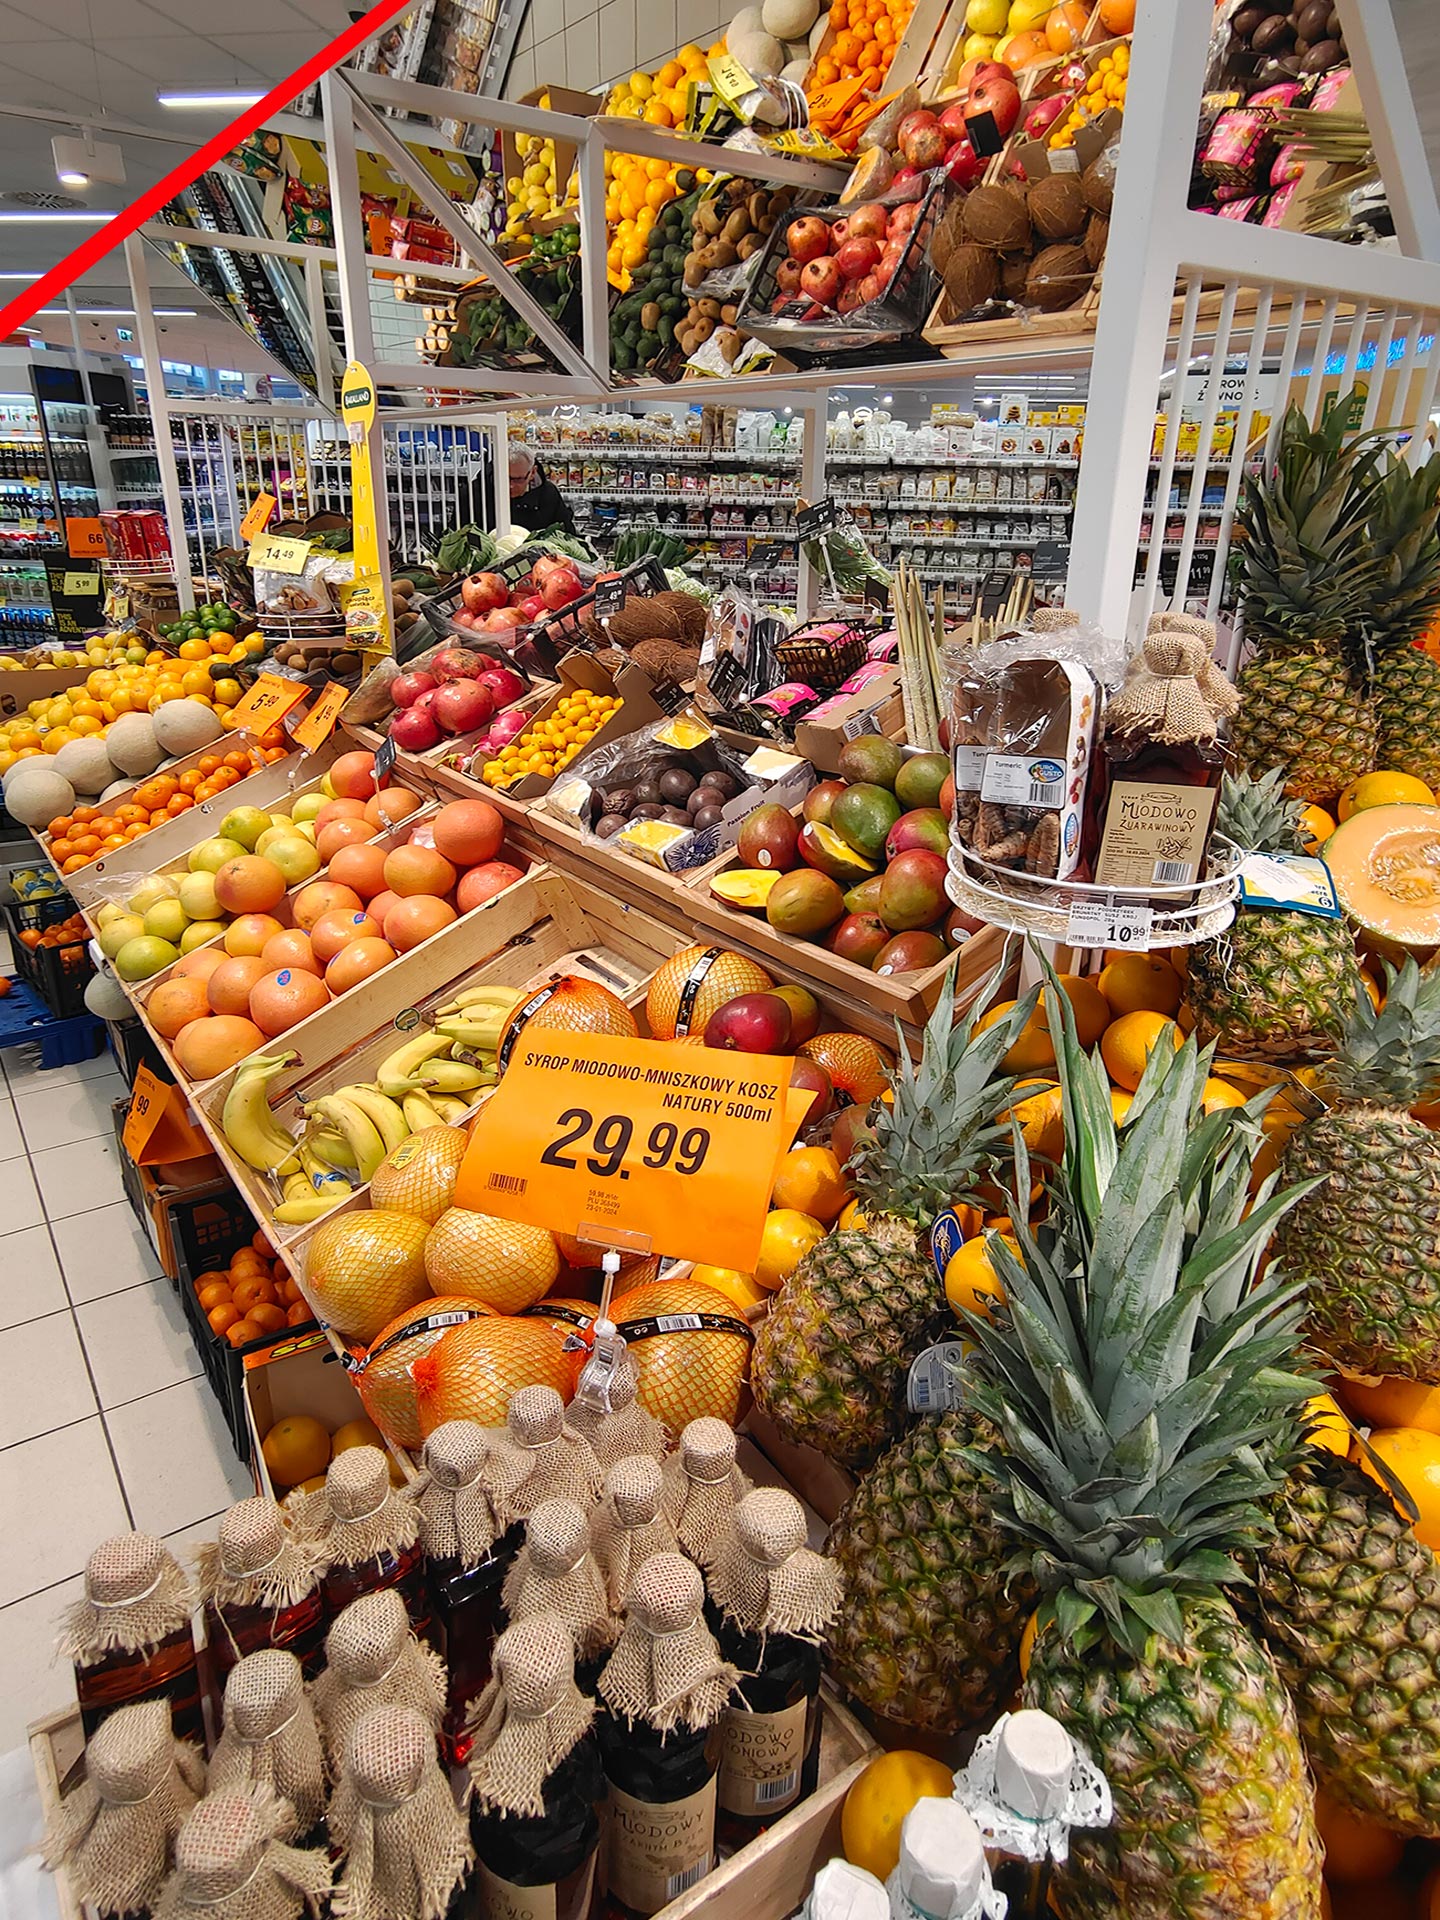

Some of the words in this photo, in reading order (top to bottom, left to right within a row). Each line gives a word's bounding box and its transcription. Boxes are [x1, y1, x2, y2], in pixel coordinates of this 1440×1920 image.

[1203, 379, 1248, 388] ZROW
[266, 547, 295, 561] 14.49
[995, 761, 1022, 769] Turmeric
[1121, 800, 1197, 820] MIODOWO
[524, 1052, 570, 1071] SYROP
[571, 1058, 735, 1094] MIODOWO-MNISZKOWY
[737, 1081, 778, 1101] KOSZ
[662, 1093, 723, 1114] NATURY
[725, 1102, 773, 1122] 500ml
[727, 1727, 794, 1745] ODOWO
[613, 1805, 704, 1838] MIODOWY
